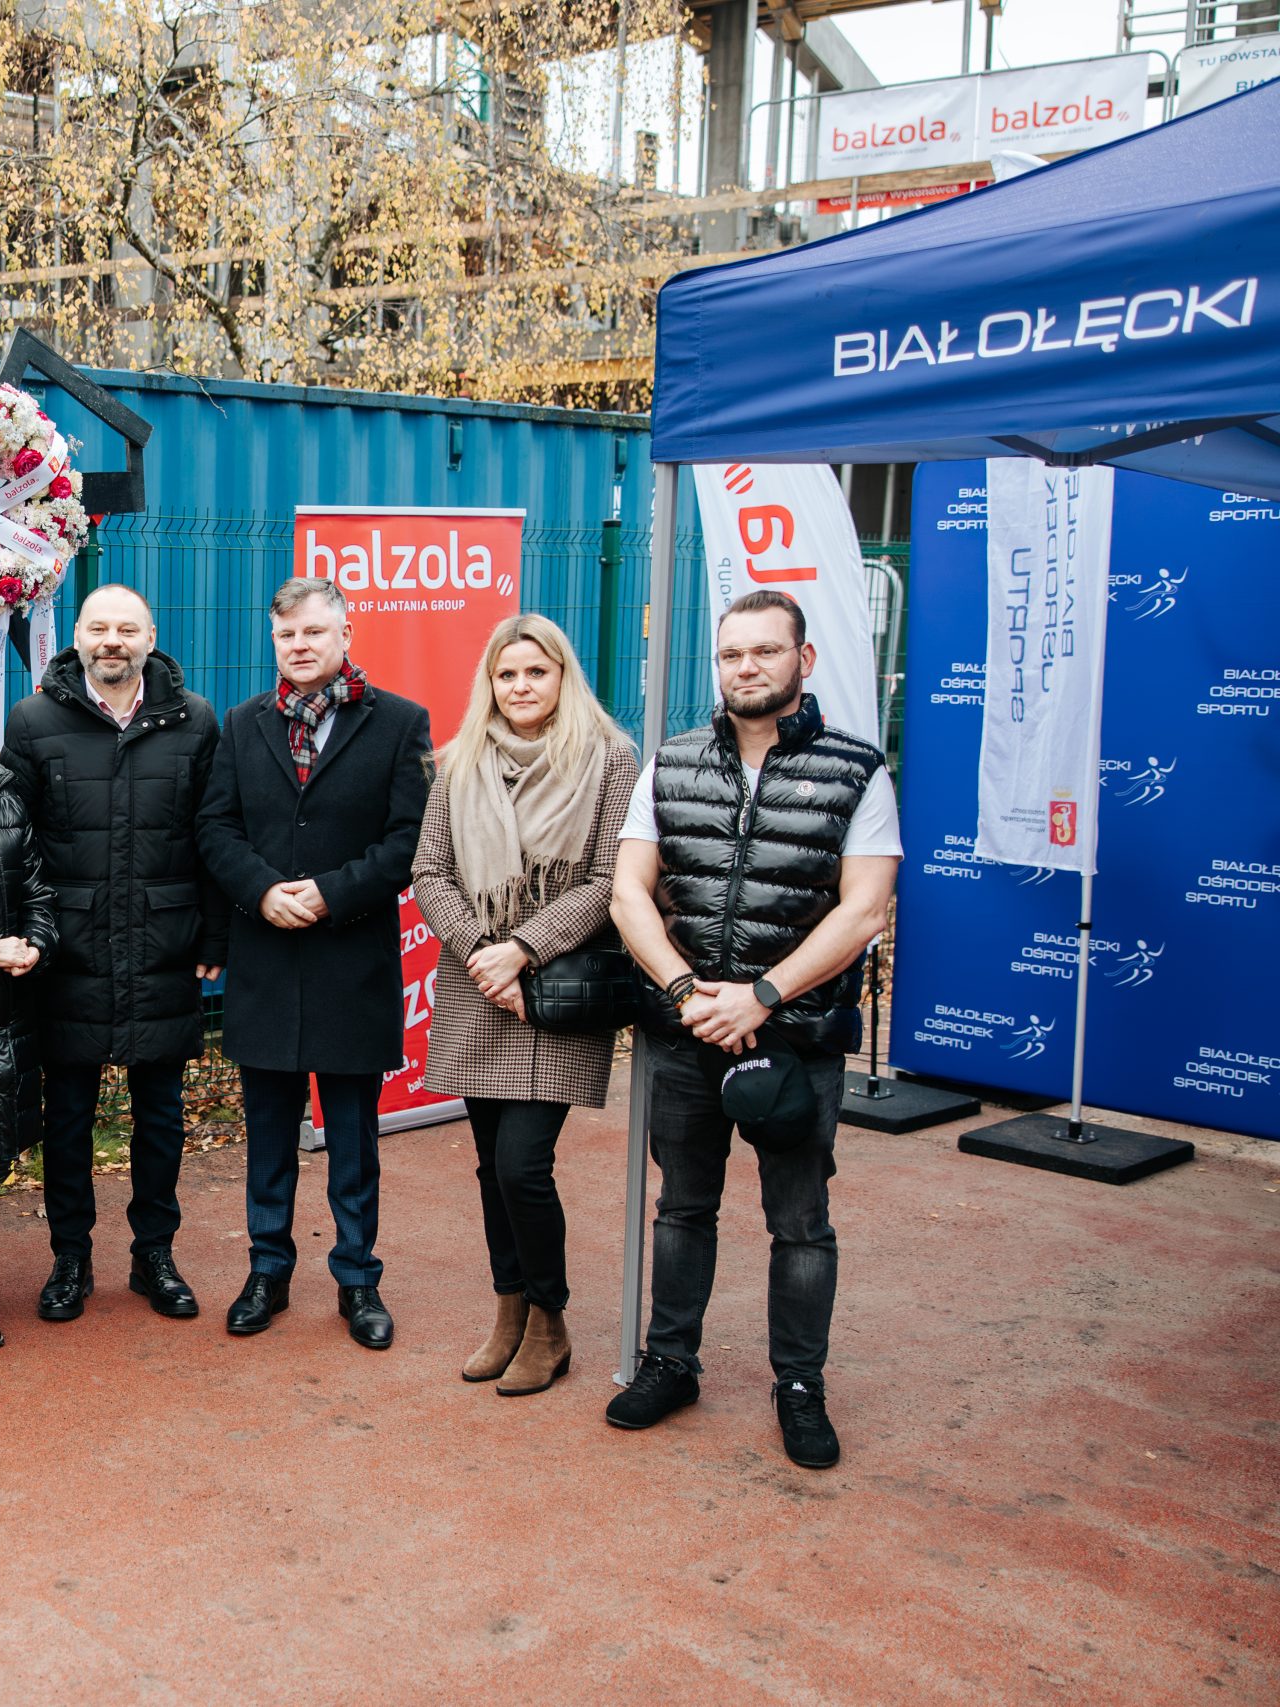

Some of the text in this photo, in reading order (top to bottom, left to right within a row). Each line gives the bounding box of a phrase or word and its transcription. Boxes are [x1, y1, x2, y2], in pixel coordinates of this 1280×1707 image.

[1198, 57, 1216, 67] TU
[991, 95, 1113, 133] balzola
[833, 116, 946, 152] balzola
[833, 277, 1258, 377] BIAŁOŁĘCKI
[4, 477, 37, 500] balzola
[947, 502, 988, 514] OŚRO
[1209, 509, 1280, 521] SPORTU
[937, 519, 989, 531] SPORT
[12, 532, 43, 555] balzola
[306, 529, 491, 591] balzola
[359, 600, 374, 612] OF
[377, 600, 428, 612] LANTANIA
[430, 599, 466, 611] GROUP
[38, 633, 47, 666] balzola
[940, 677, 986, 689] OŚRO
[1209, 685, 1280, 698] OŚRODE
[1197, 703, 1269, 716] SPORTU
[923, 864, 982, 879] SPORTU
[1212, 860, 1280, 877] BIAŁOŁĘ
[1185, 891, 1256, 908] SPORTU
[1010, 962, 1073, 979] SPORTU
[935, 1004, 1015, 1026] BIAŁOŁĘCKI
[924, 1018, 994, 1039] OŚRODEK
[914, 1031, 971, 1050] SPORTU
[1199, 1046, 1280, 1069] BIAŁOŁĘC
[1185, 1061, 1271, 1085] OŚRODEK
[1173, 1077, 1244, 1098] SPORTU
